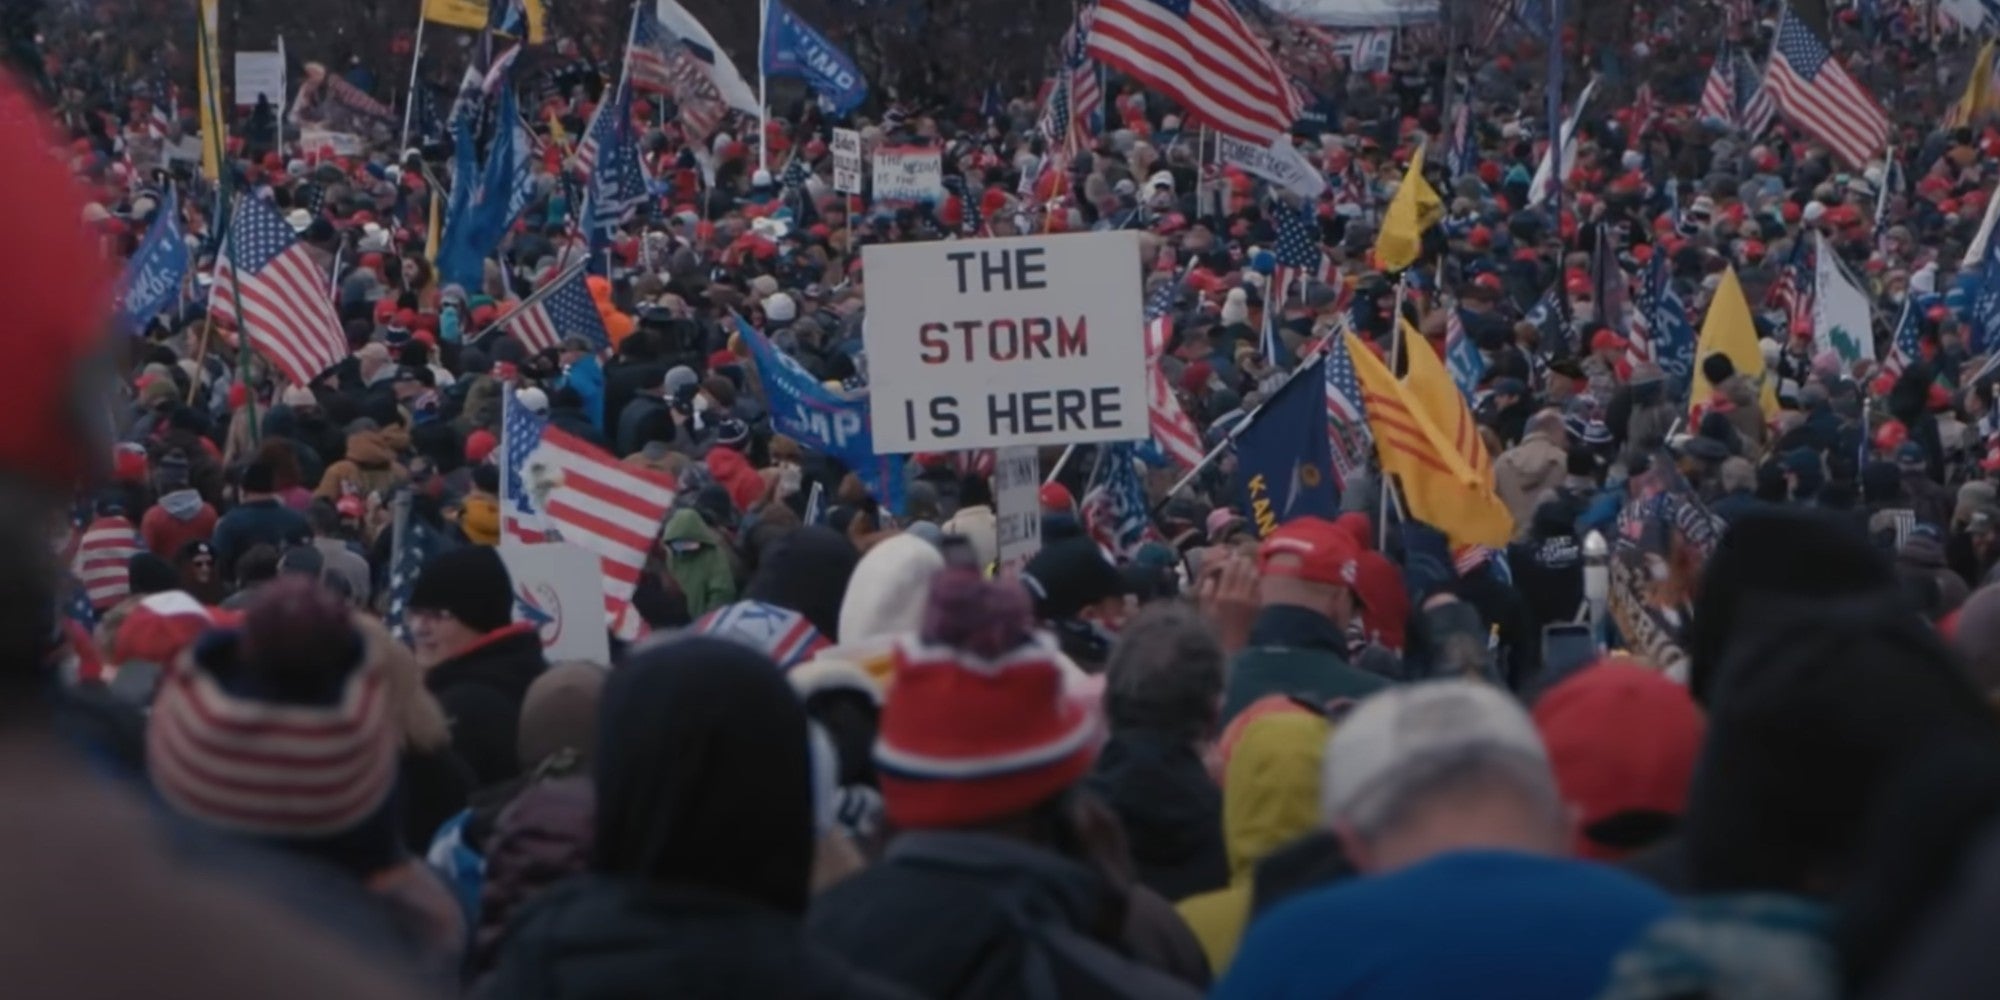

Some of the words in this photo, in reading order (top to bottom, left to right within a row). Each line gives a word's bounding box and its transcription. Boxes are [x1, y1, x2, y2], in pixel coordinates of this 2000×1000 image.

[947, 248, 1046, 293] THE
[919, 314, 1088, 364] STORM
[905, 396, 960, 441] IS
[987, 386, 1122, 436] HERE
